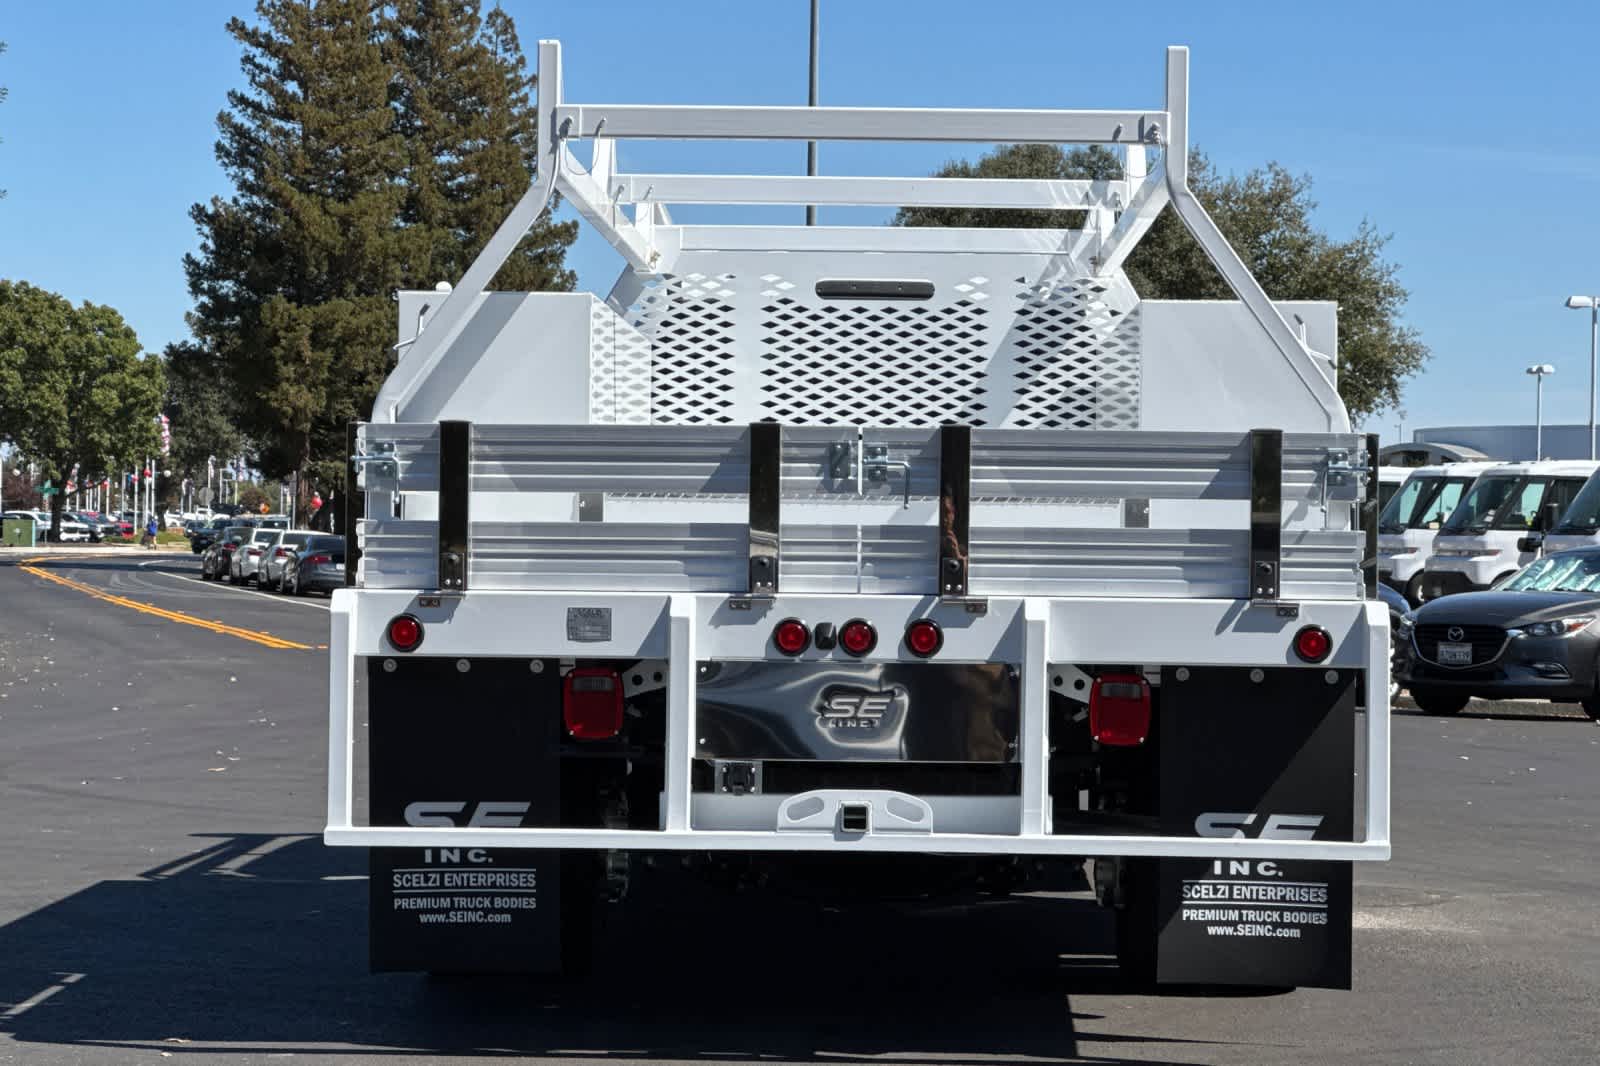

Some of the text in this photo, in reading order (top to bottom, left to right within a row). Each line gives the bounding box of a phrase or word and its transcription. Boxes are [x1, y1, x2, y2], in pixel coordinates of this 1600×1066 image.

[824, 696, 891, 719] SE
[424, 849, 494, 863] INC.
[1213, 860, 1284, 877] INC.
[392, 873, 537, 888] SCELZI ENTERPRISES
[1182, 885, 1329, 903] SCELZI ENTERPRISES
[393, 897, 537, 910] PREMIUM TRUCK BODIES
[419, 911, 512, 923] www.SEINC.com
[1182, 909, 1329, 925] PREMIUM TRUCK BODIES
[1207, 924, 1301, 938] www.SEINC.com
